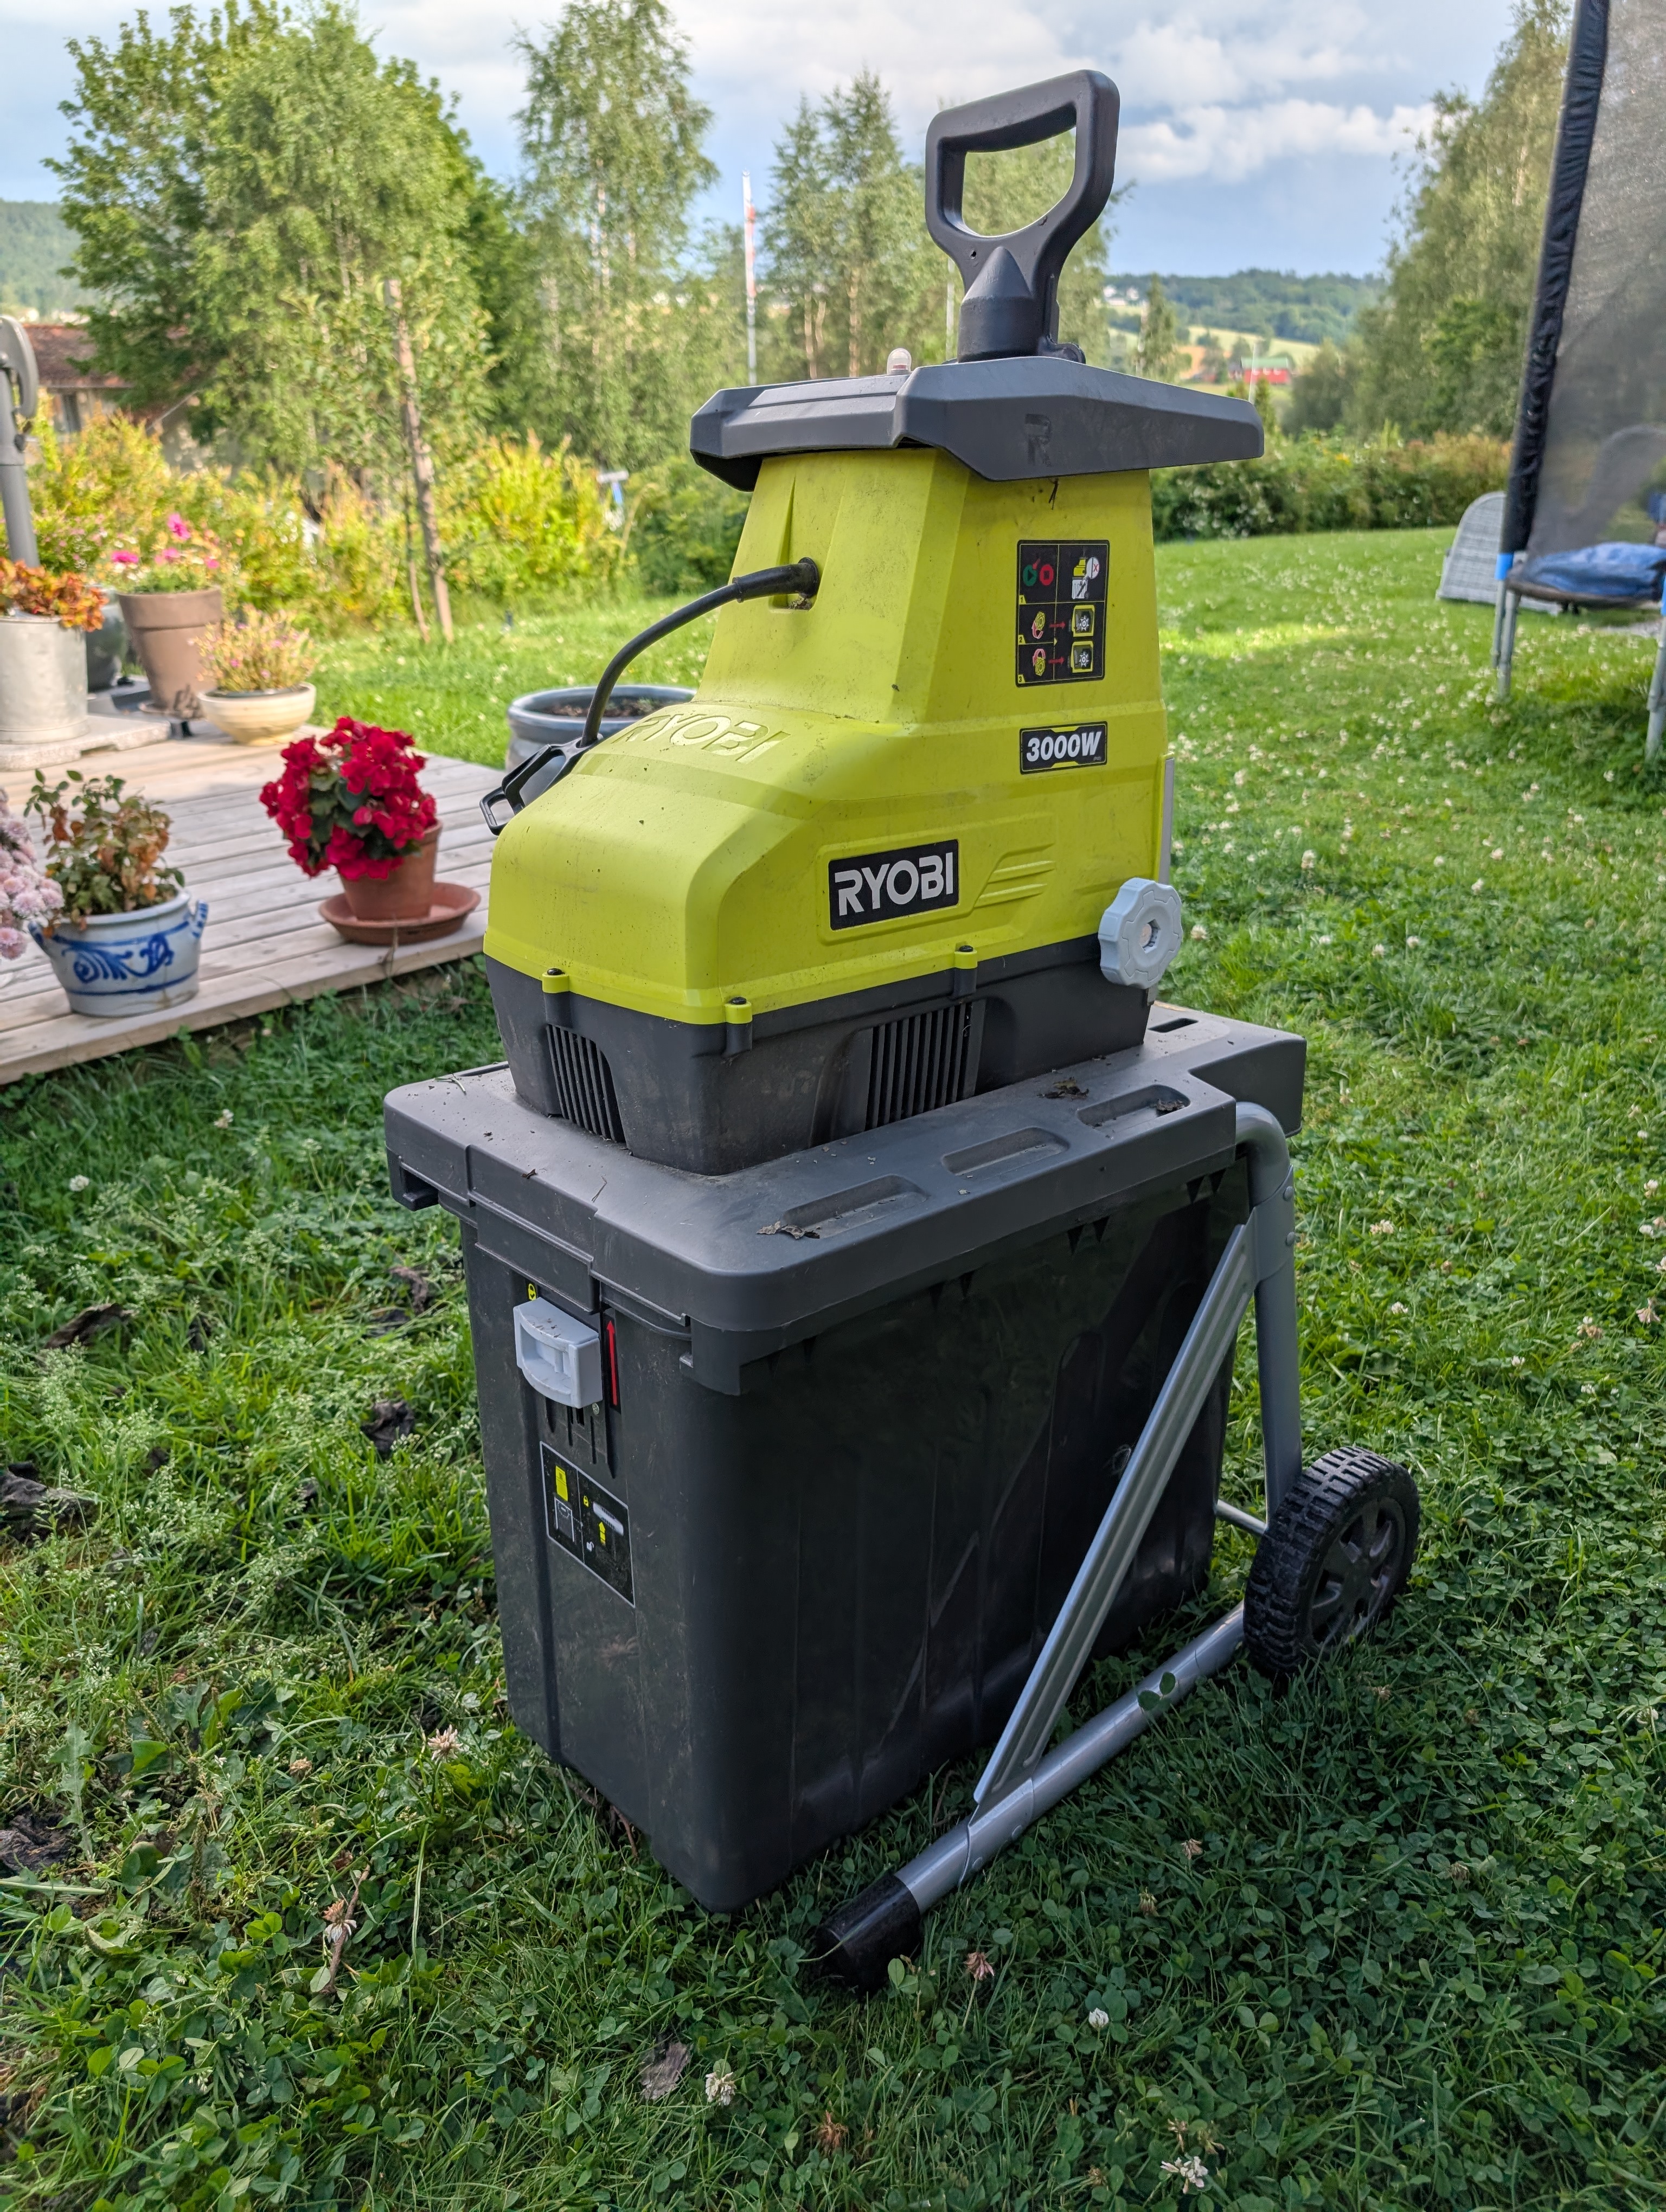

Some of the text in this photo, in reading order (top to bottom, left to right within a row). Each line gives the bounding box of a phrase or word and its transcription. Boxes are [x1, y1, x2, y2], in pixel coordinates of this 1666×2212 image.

[611, 713, 791, 763] RYOBI
[1027, 731, 1102, 762] 3000W
[835, 852, 953, 916] RYOBI
